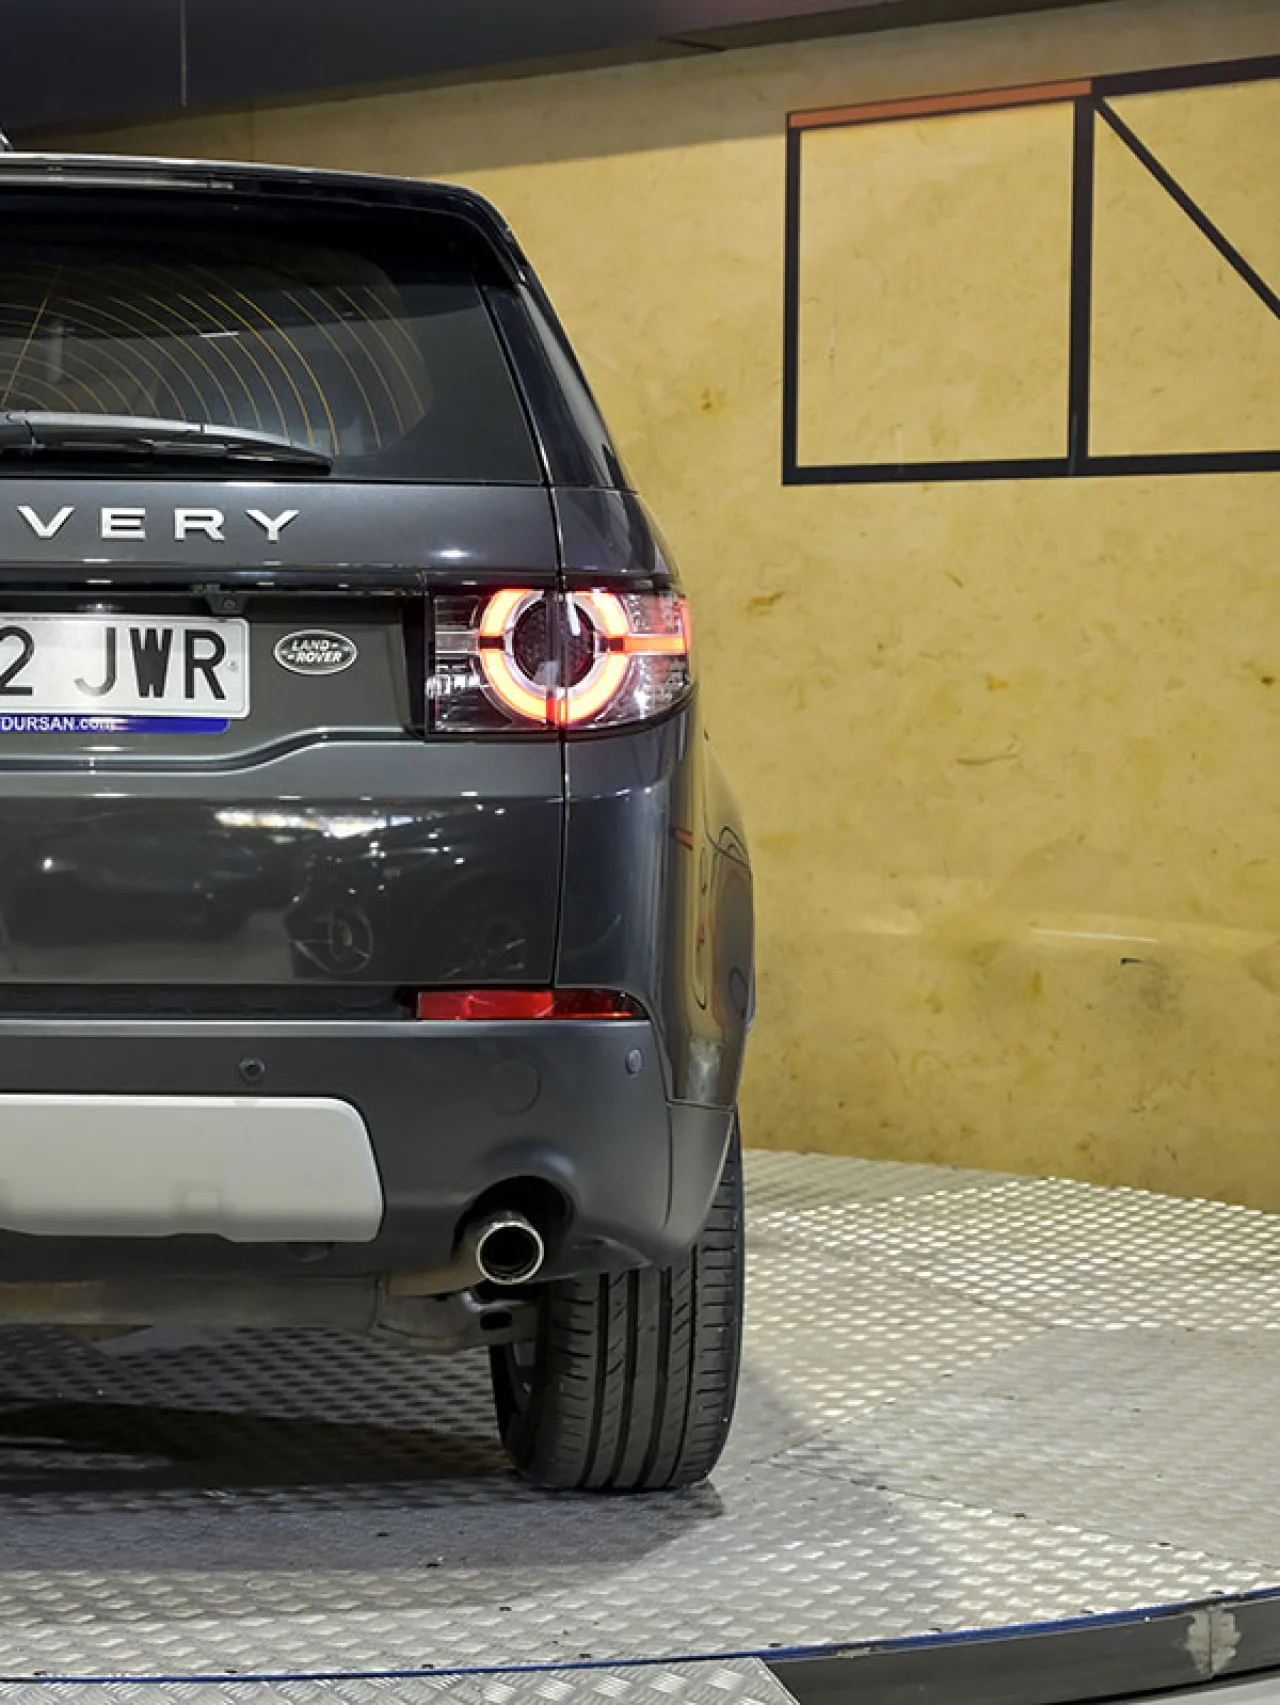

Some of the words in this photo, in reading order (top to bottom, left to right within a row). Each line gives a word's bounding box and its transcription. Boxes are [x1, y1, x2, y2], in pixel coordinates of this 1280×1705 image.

[291, 639, 330, 652] LAND
[296, 650, 342, 663] ROVER
[74, 626, 227, 701] JWR
